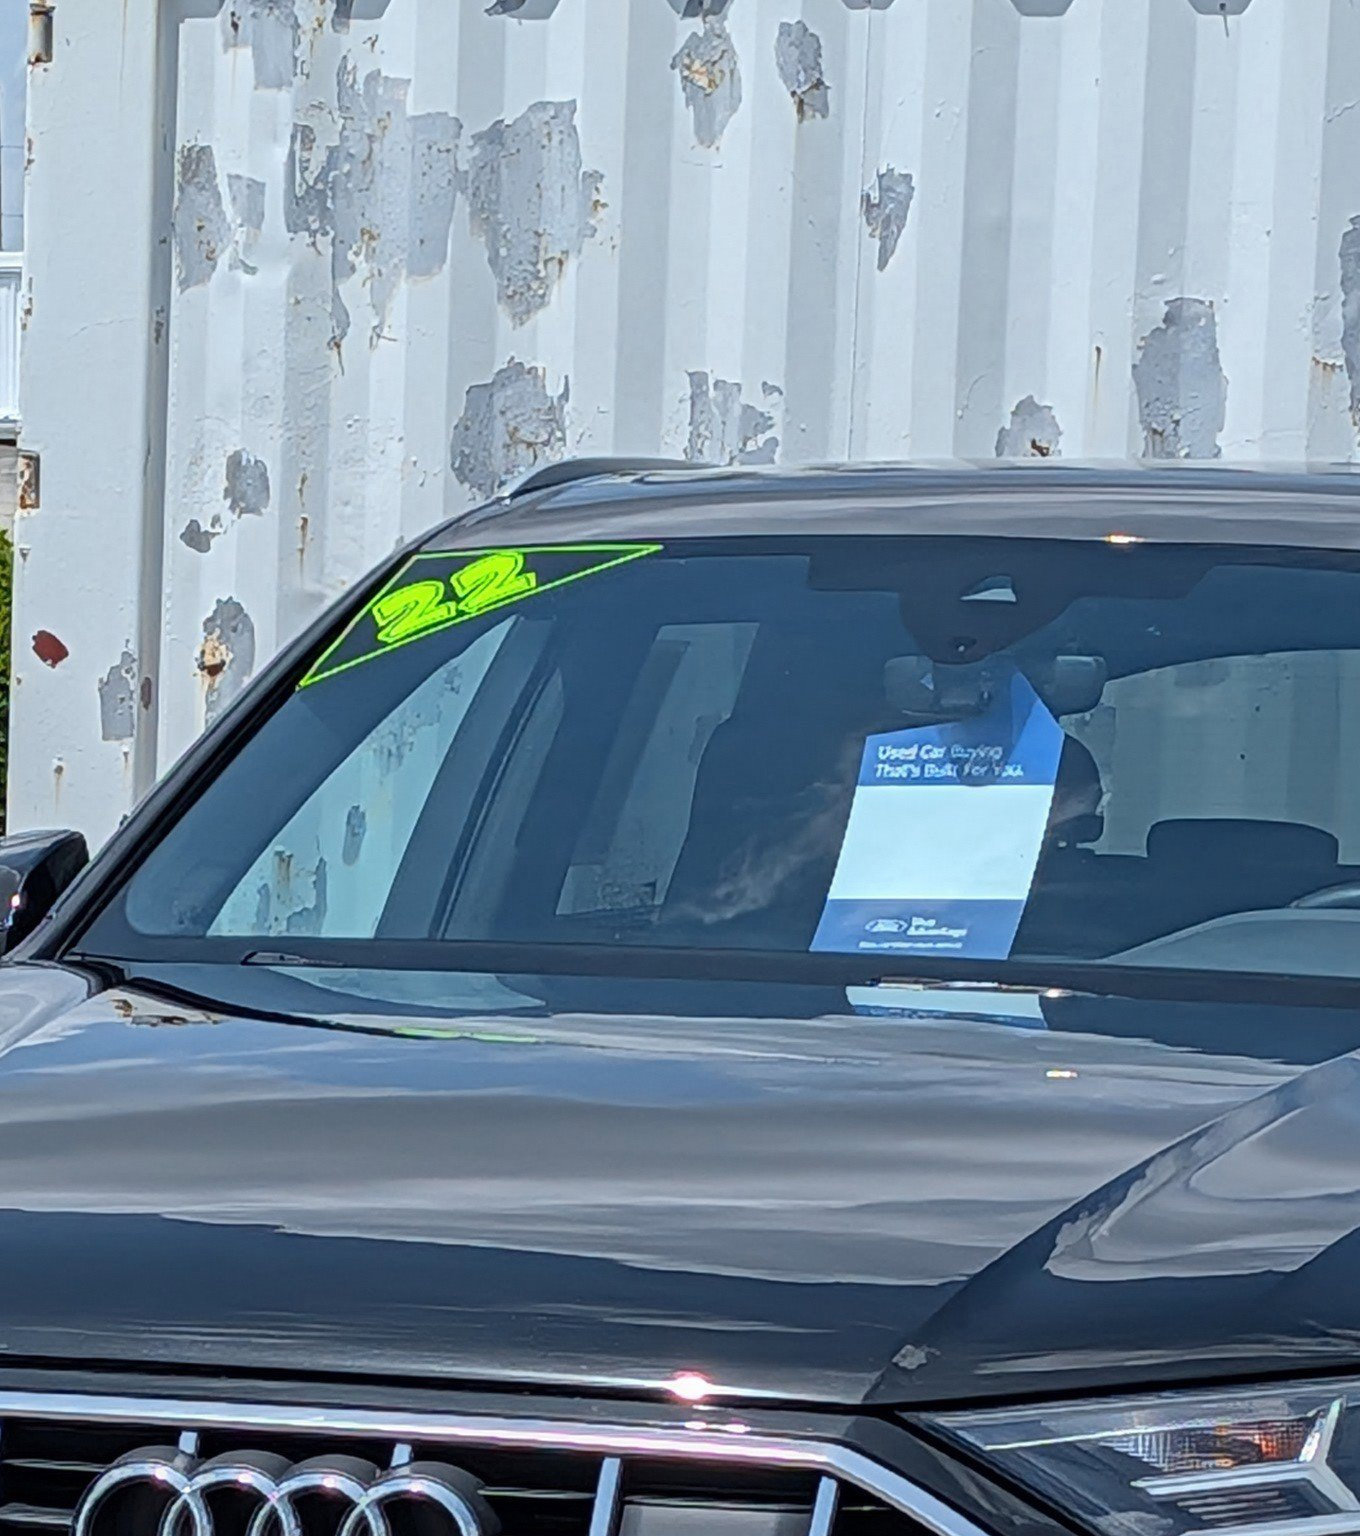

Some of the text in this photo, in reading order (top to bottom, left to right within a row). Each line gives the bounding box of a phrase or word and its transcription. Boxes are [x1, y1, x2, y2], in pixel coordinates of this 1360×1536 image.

[371, 551, 537, 643] 22
[877, 744, 918, 760] Used
[920, 744, 946, 760] Car
